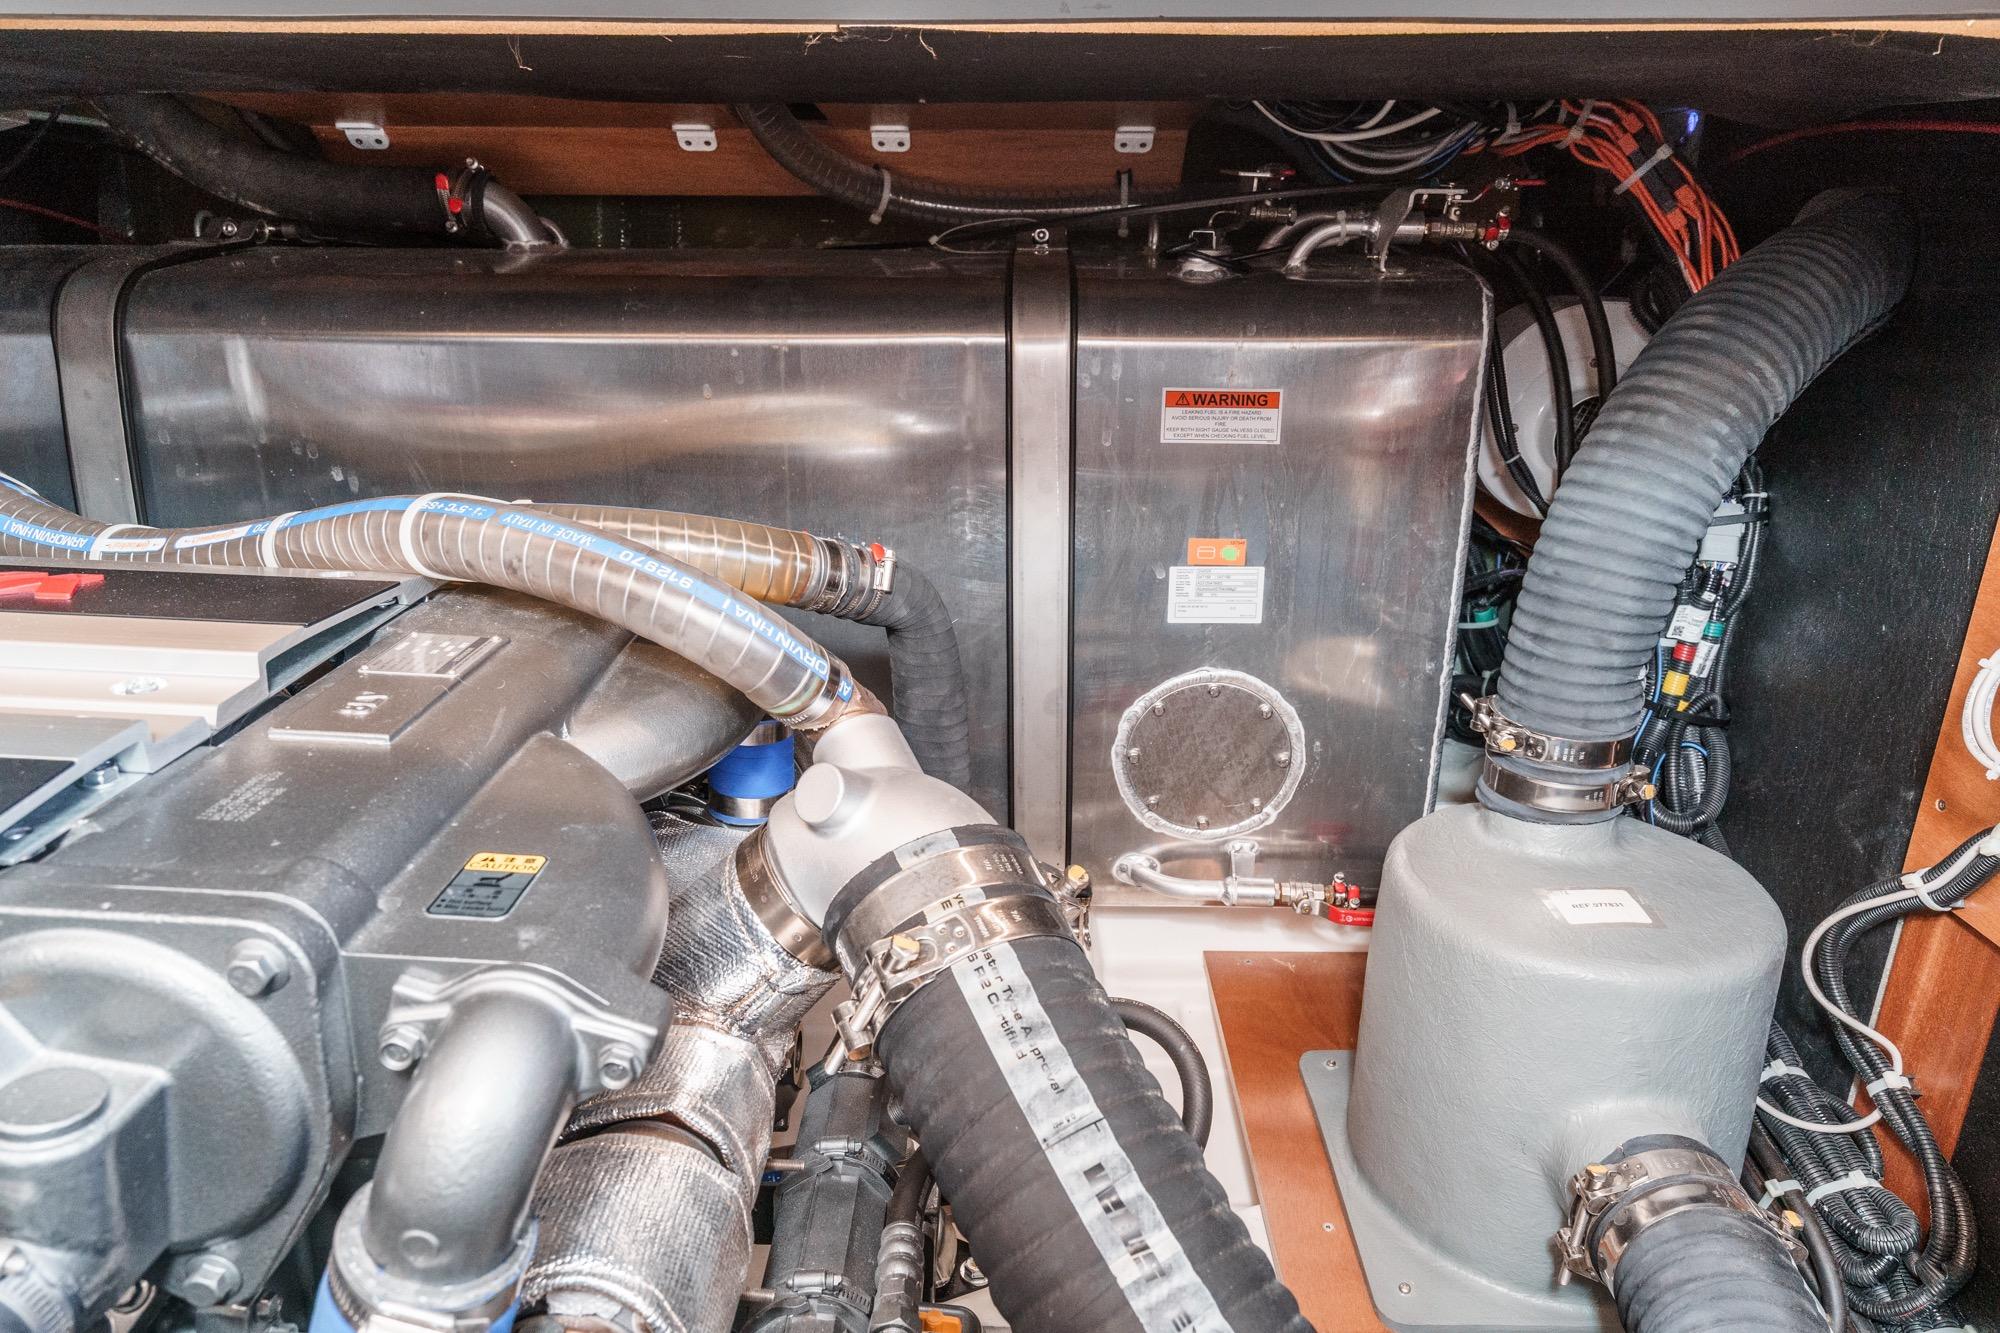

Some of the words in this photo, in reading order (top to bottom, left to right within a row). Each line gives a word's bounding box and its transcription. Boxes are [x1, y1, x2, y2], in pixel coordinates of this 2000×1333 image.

[1192, 393, 1269, 406] WARNING
[501, 513, 537, 530] ITALY
[538, 523, 553, 535] IN
[32, 528, 89, 549] ARMORVIN
[555, 527, 596, 547] MADE
[735, 604, 774, 636] HNA
[469, 862, 539, 871] CAUTION
